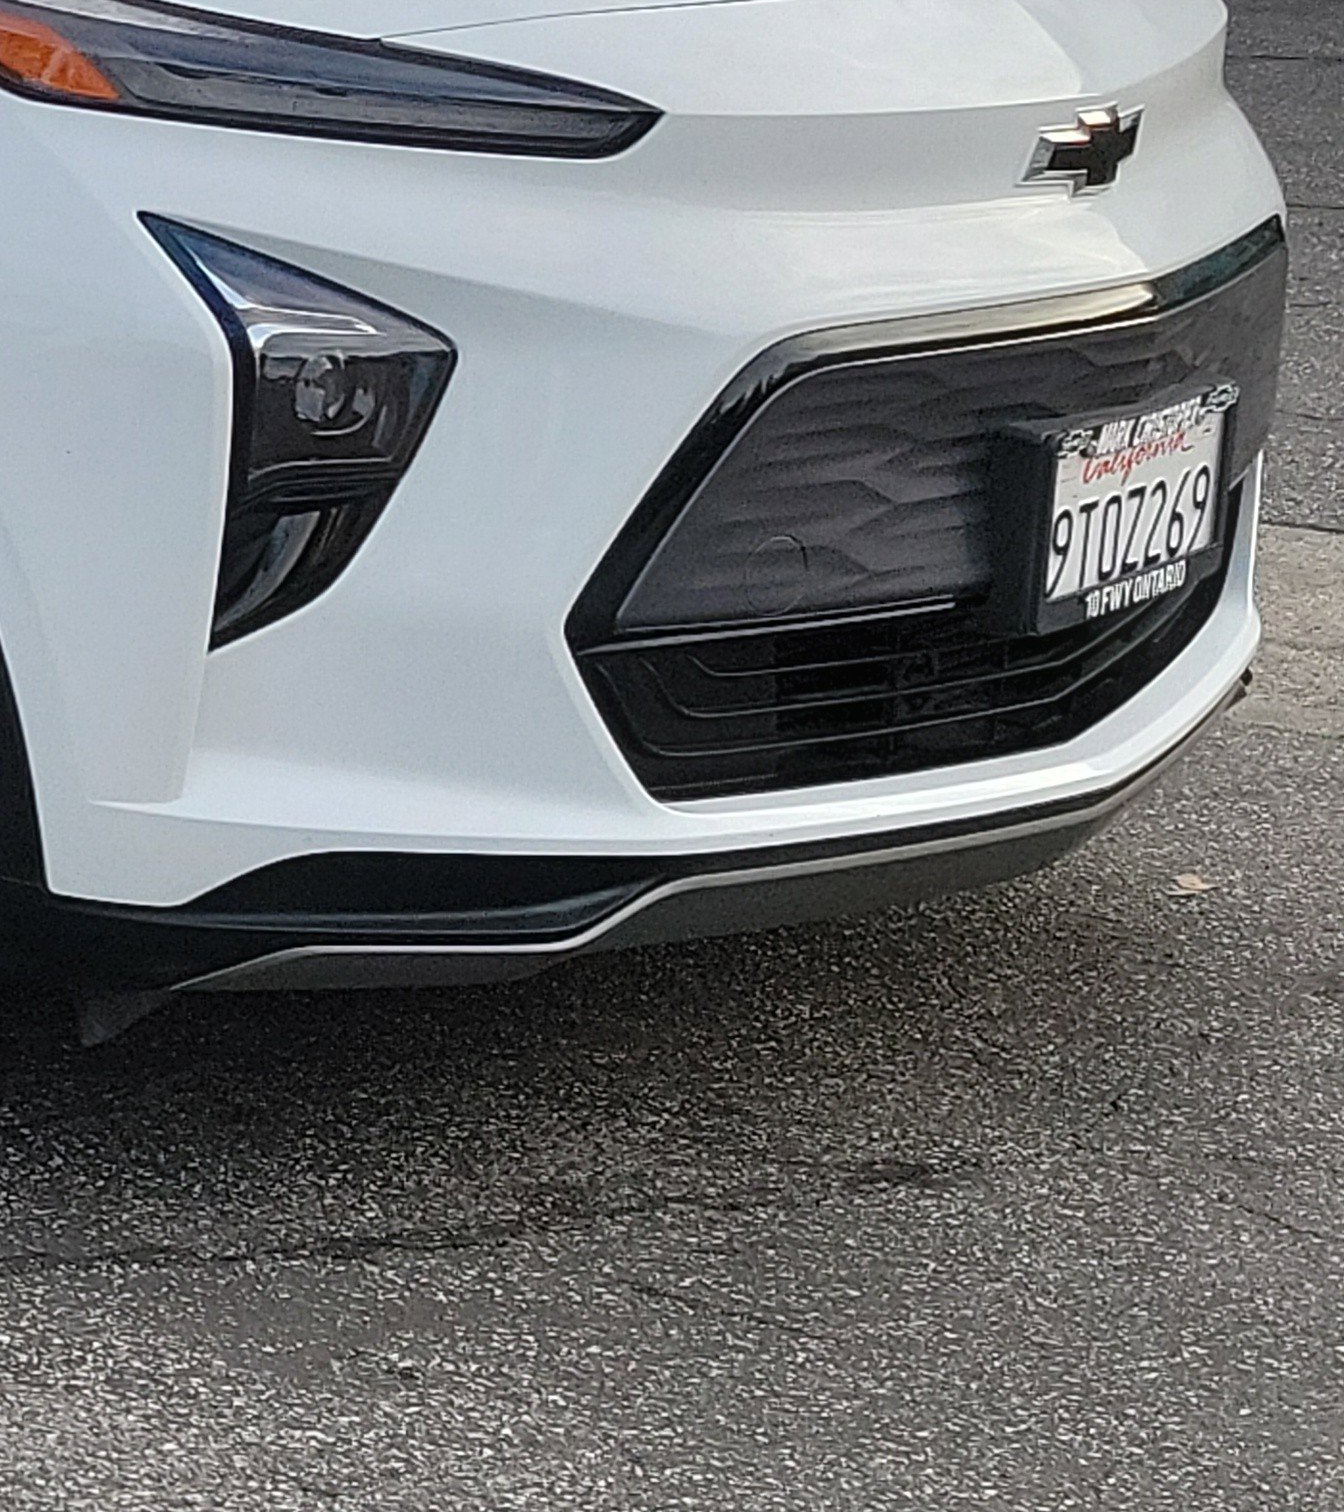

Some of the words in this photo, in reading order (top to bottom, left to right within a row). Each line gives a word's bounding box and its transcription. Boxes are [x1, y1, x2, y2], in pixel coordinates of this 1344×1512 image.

[1082, 430, 1194, 486] California
[1085, 589, 1099, 619] 10
[1100, 579, 1133, 615] FWY
[1133, 558, 1187, 602] ONTARIO
